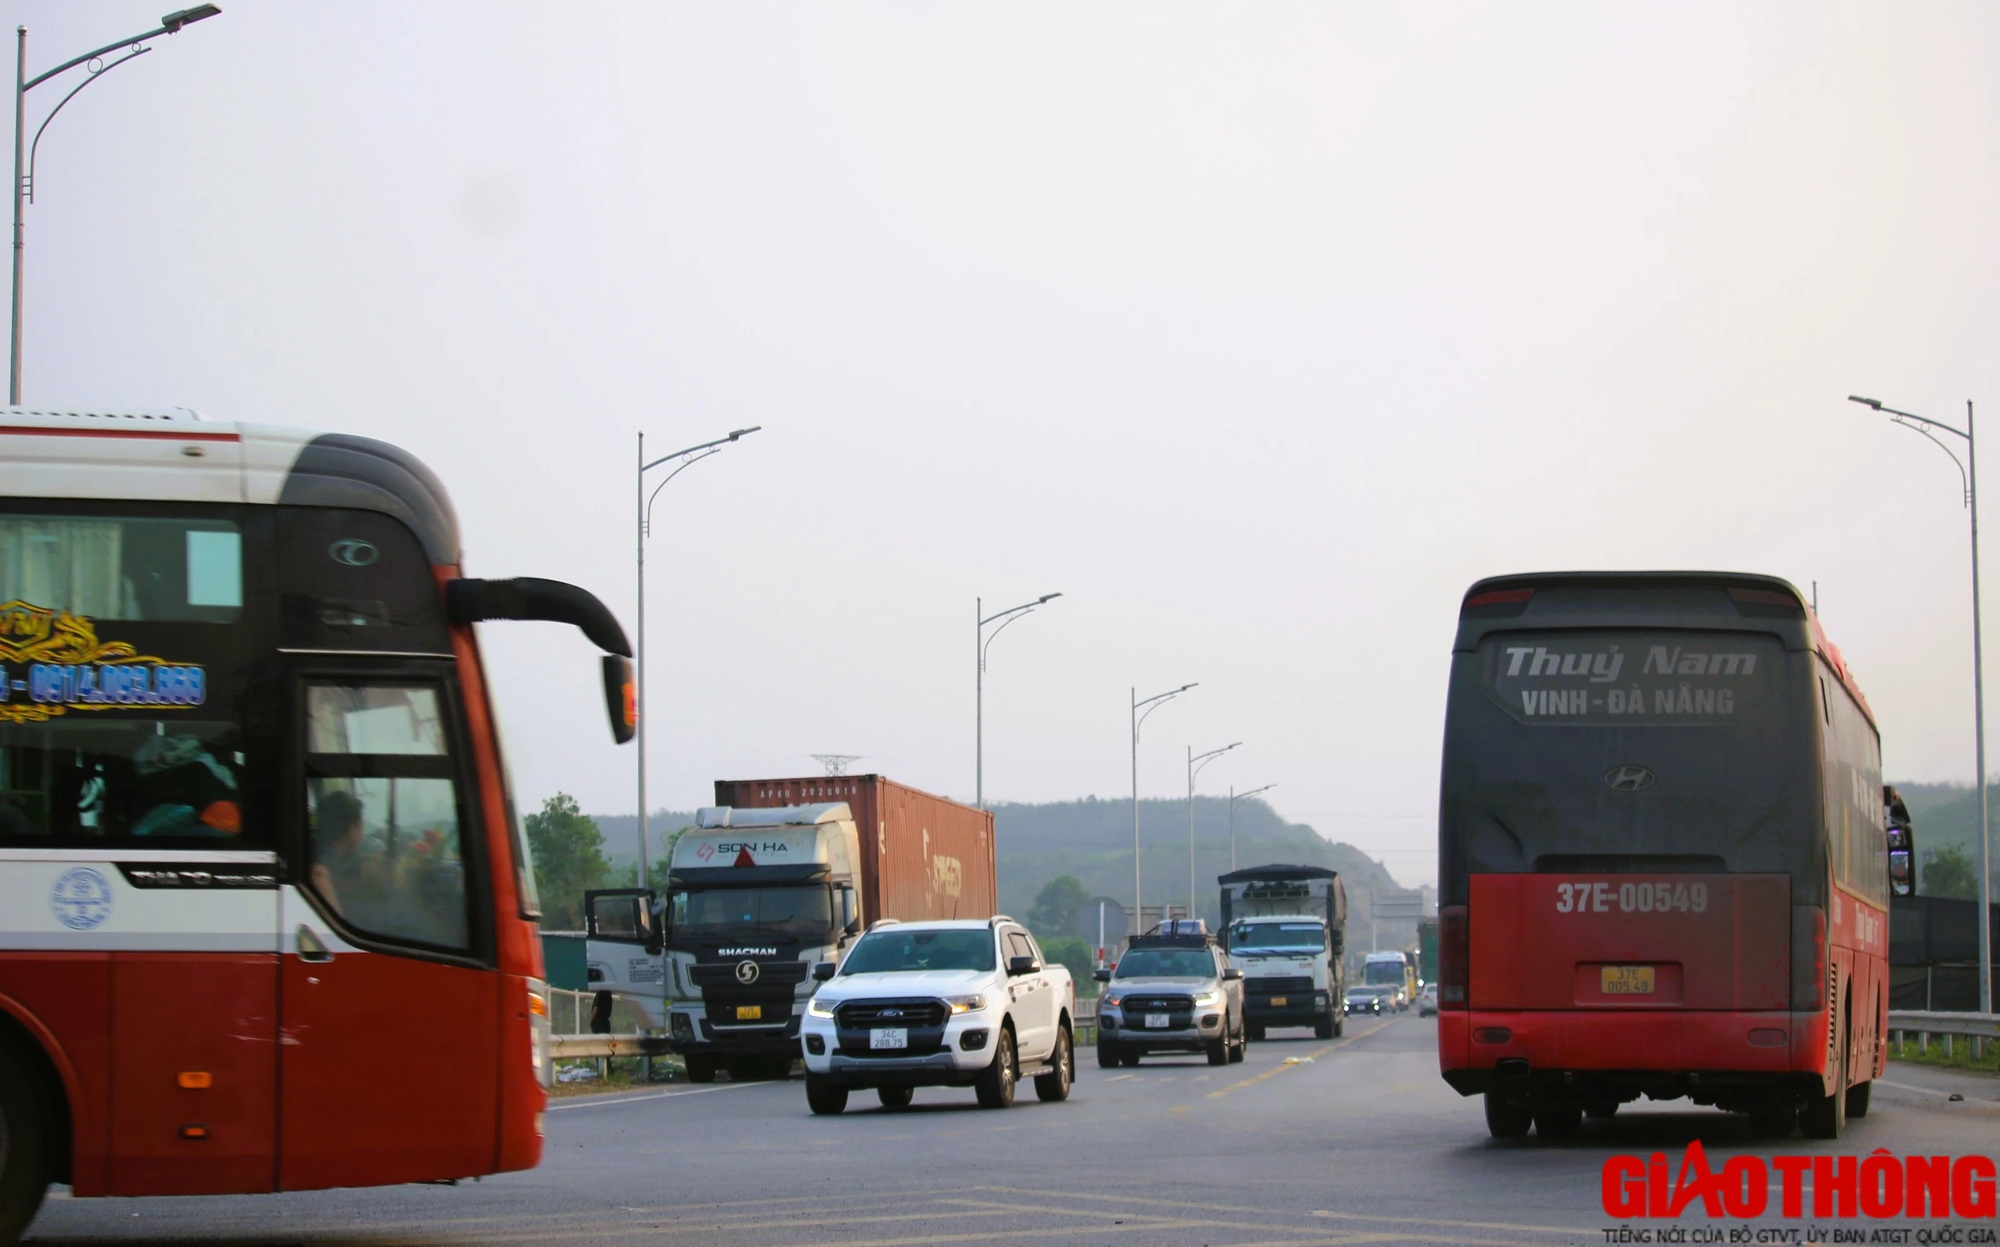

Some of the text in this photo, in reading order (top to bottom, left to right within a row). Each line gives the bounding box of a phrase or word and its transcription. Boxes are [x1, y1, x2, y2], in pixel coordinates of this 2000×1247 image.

[1506, 645, 1757, 683] Thuỷ Nam
[1522, 689, 1588, 716] VINH
[1608, 684, 1646, 715] ĐÀ
[760, 790, 790, 799] APKU
[717, 842, 788, 853] SON HA
[1556, 883, 1708, 913] 37E-00549
[718, 947, 777, 956] SHACMAN
[1617, 968, 1639, 980] 37E
[1607, 981, 1649, 993] 005.49
[881, 1030, 896, 1039] 34C
